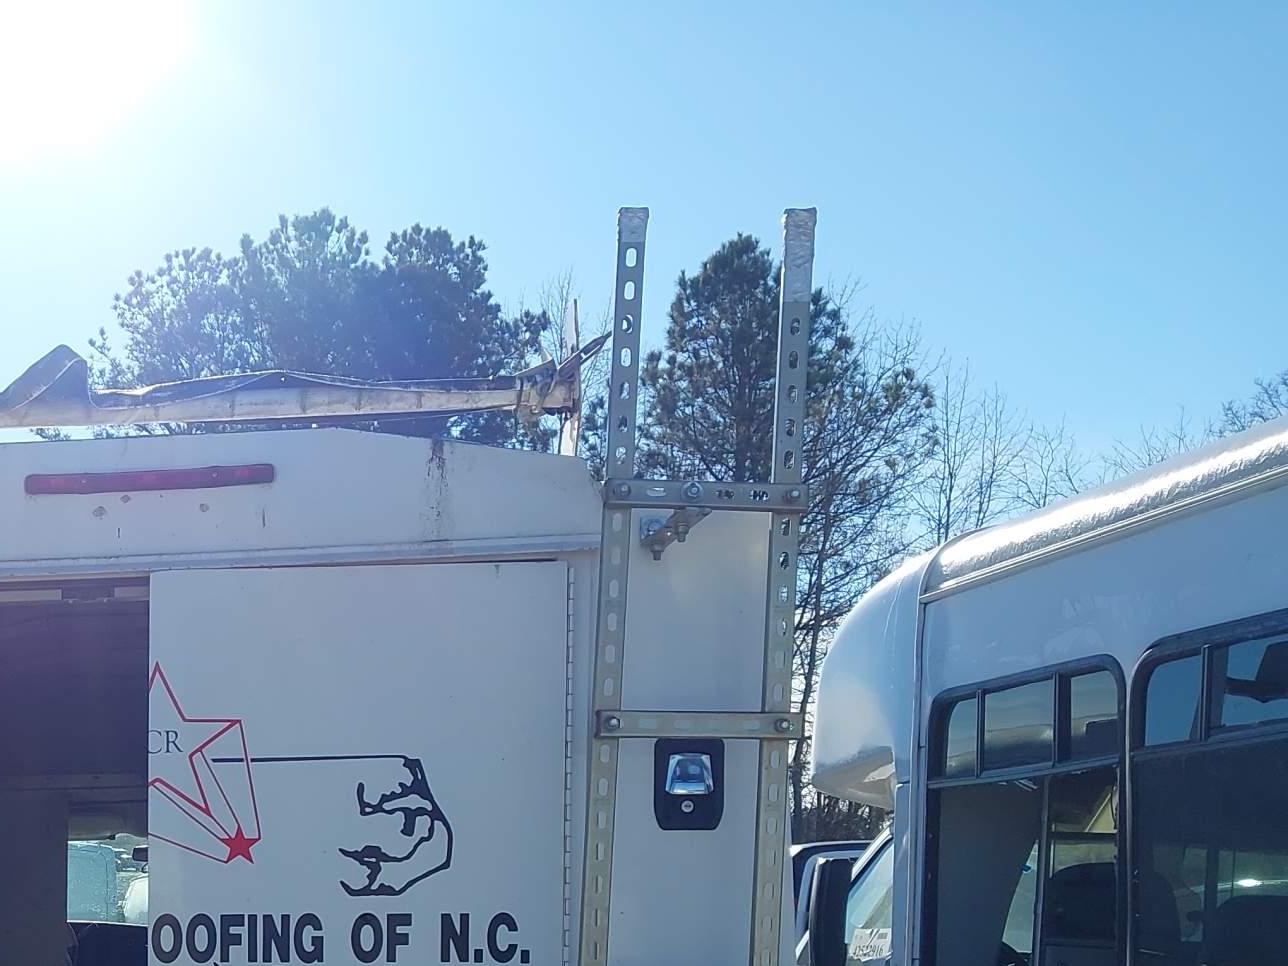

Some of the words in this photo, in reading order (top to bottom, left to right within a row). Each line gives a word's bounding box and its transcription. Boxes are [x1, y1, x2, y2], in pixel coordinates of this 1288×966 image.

[151, 913, 324, 963] OOFING
[351, 913, 412, 963] OF
[440, 913, 530, 963] N.C.
